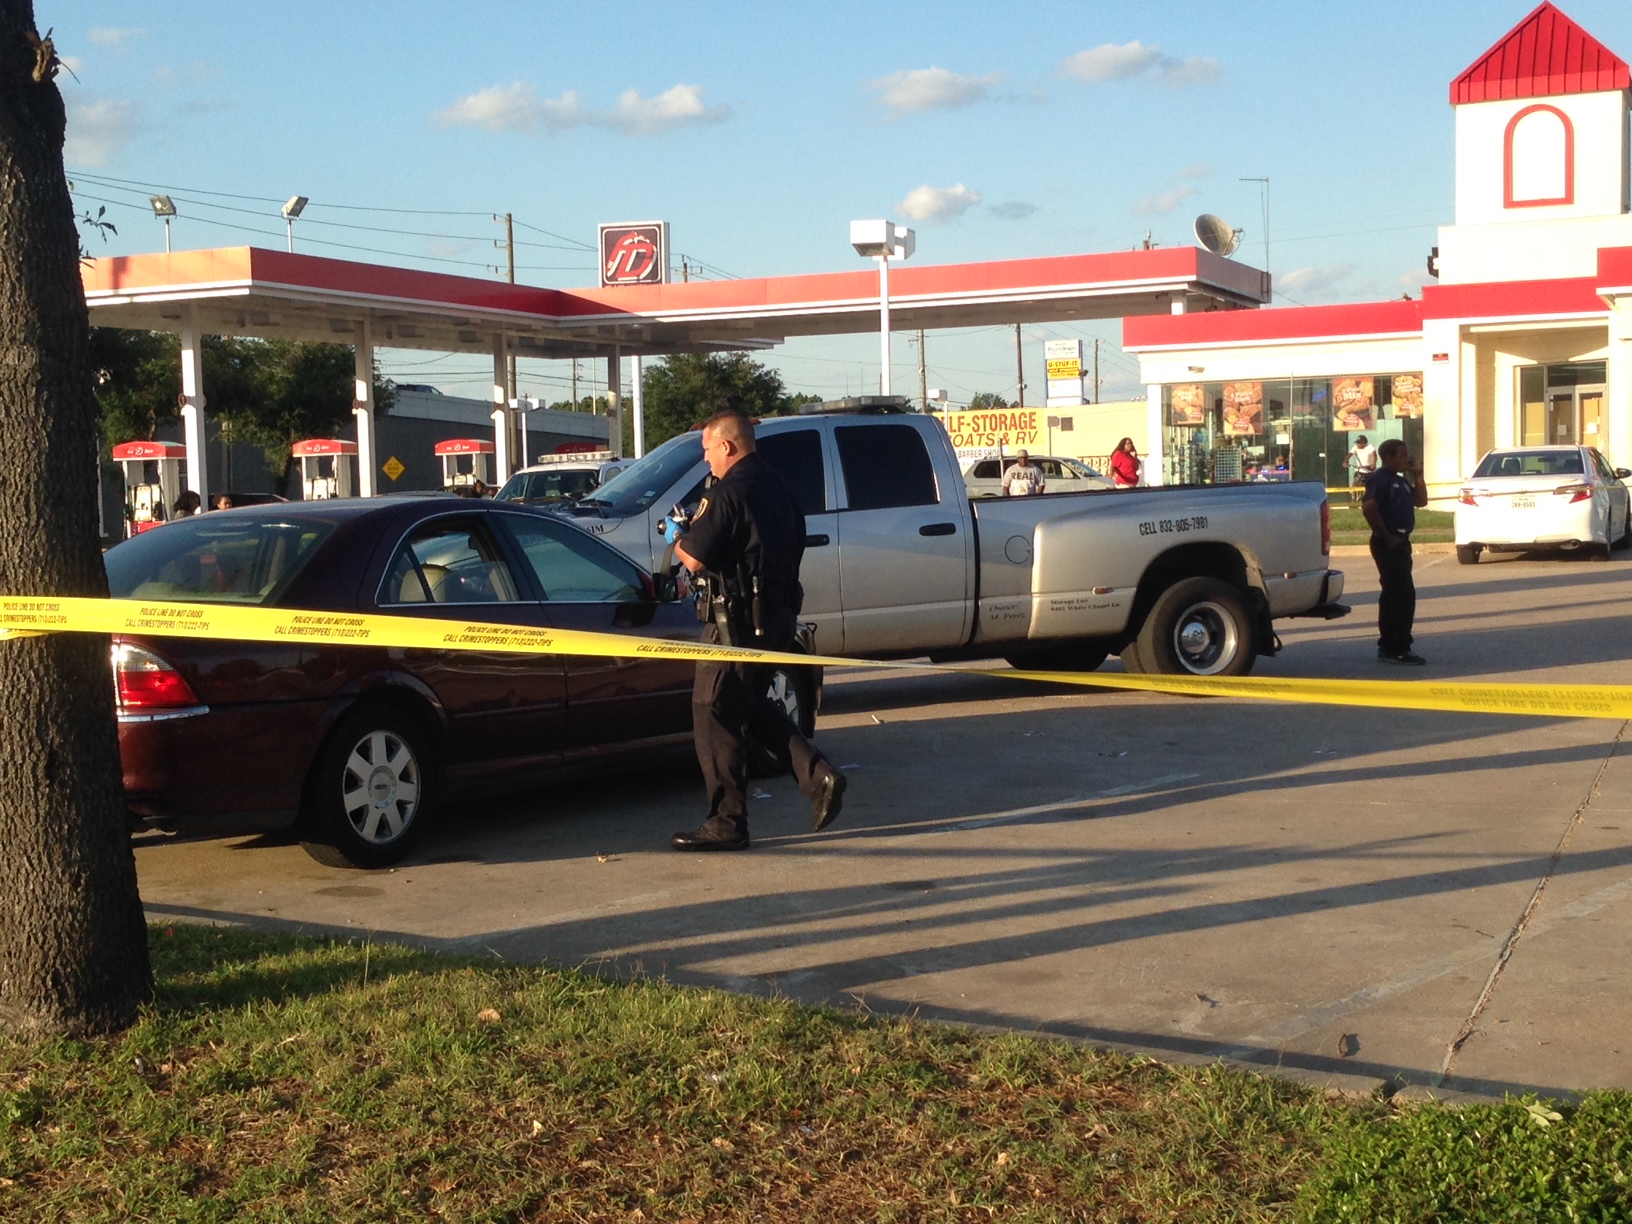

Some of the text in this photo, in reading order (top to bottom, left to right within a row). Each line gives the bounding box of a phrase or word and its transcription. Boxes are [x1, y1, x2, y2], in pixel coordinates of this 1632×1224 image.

[941, 412, 1037, 432] LF-STORAGE
[949, 432, 996, 447] OATS
[1016, 431, 1038, 445] RV
[958, 450, 982, 458] BARBER
[1011, 472, 1034, 480] REAL
[1139, 521, 1157, 536] CELL
[140, 607, 204, 618] POLICE LINE DO NOT CROSS
[125, 618, 136, 627] CALL
[137, 619, 175, 629] CRIMESTOPPERS
[292, 616, 313, 624] POLICE
[312, 616, 325, 624] LINE
[345, 618, 365, 626] CROSS
[275, 625, 287, 634] CALL
[288, 626, 332, 636] CRIMESTOPPERS
[443, 634, 458, 642] CALL
[459, 634, 509, 644] CRIMESTOPPERS
[637, 644, 654, 652] CALL
[654, 646, 713, 655] CRIMESTOPPERS
